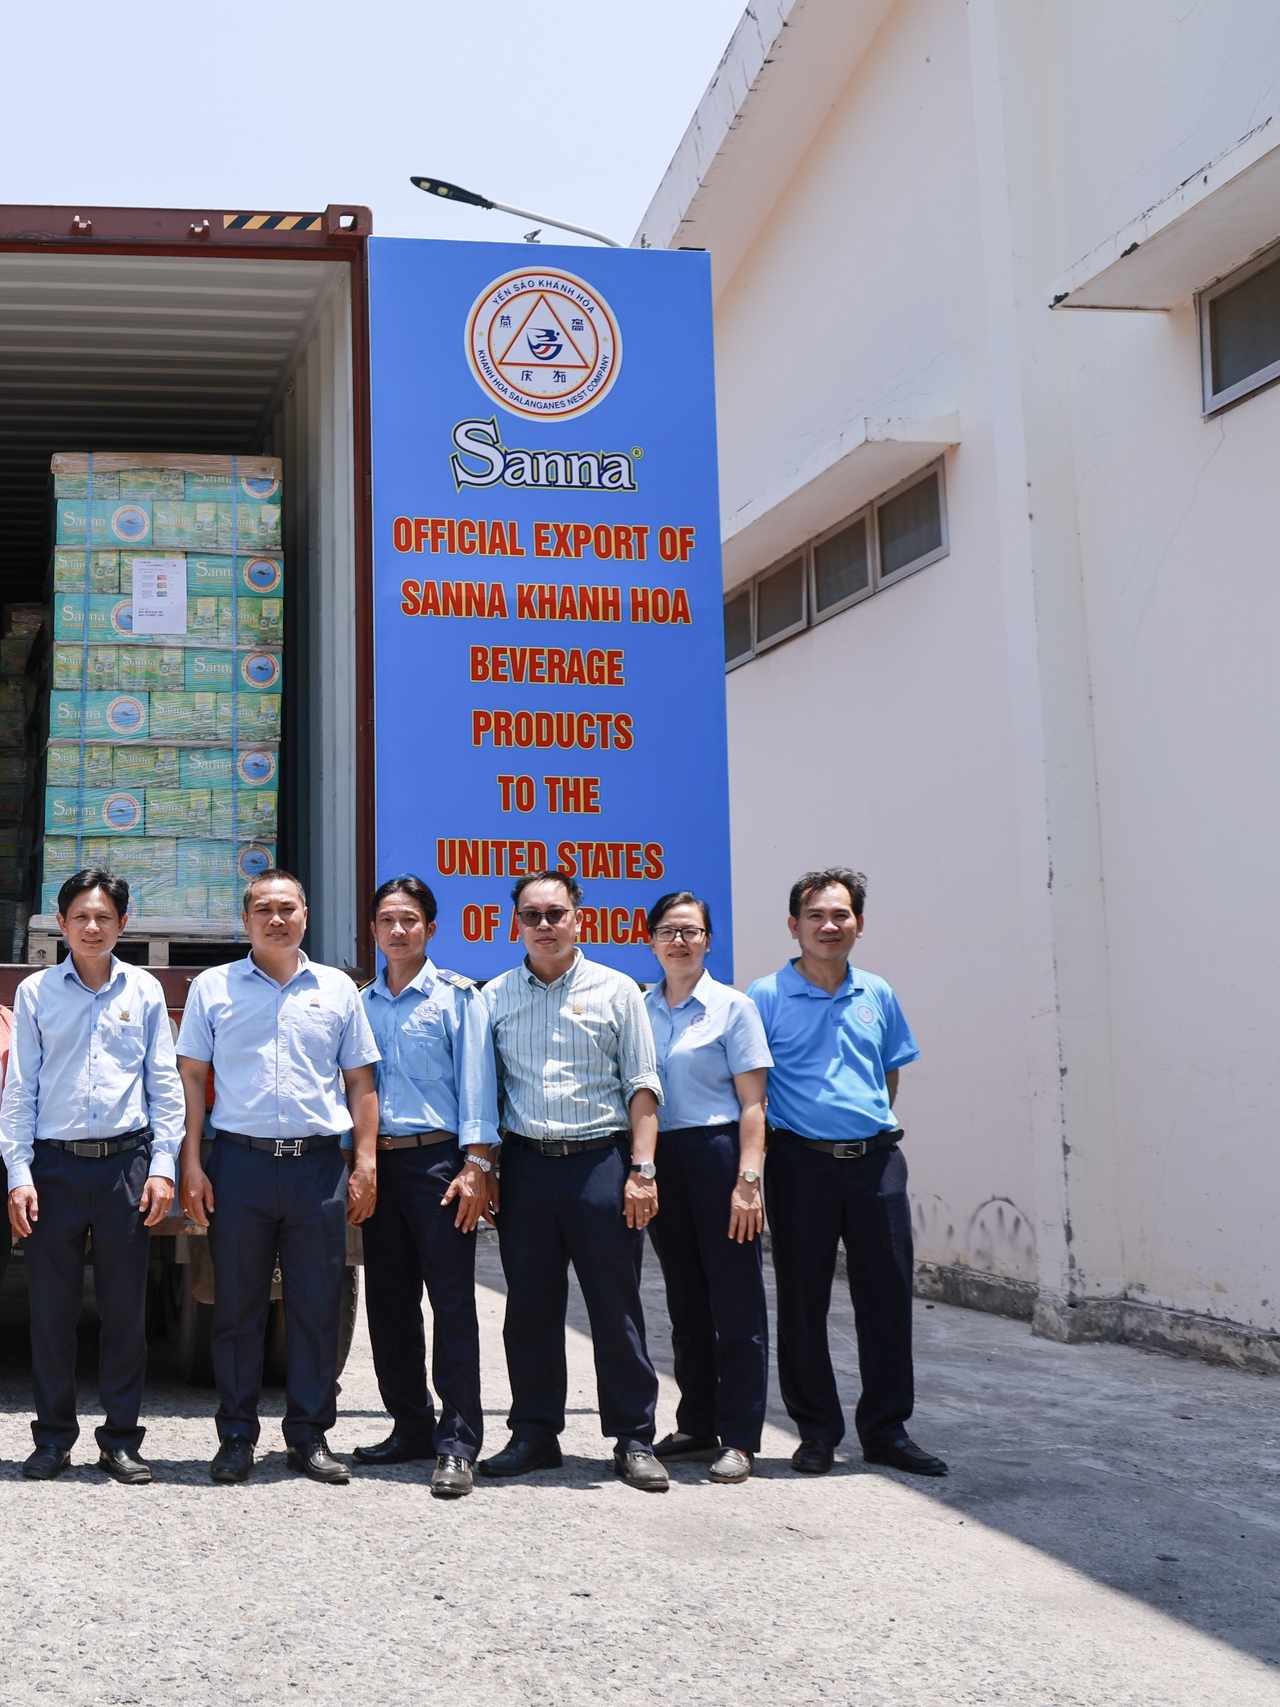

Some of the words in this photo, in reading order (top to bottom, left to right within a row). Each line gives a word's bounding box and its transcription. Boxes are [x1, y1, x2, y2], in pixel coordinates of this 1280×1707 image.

[538, 279, 575, 296] KHÁNH
[478, 349, 495, 379] KHANH
[492, 377, 508, 395] HOA
[508, 391, 566, 409] SALANGANES
[567, 390, 588, 405] NEST
[586, 354, 610, 392] COMPANY
[449, 415, 638, 494] Sanna
[392, 516, 526, 557] OFFICIAL
[533, 522, 650, 561] EXPORT
[658, 525, 695, 562] OF
[58, 556, 87, 569] Sann
[400, 579, 509, 619] SANNA
[516, 583, 622, 623] KHANH
[629, 587, 692, 625] HOA
[122, 653, 156, 666] Sanna
[469, 645, 625, 686] BEVERAGE
[472, 709, 634, 751] PRODUCTS
[189, 753, 232, 770] Sanna
[496, 774, 536, 813] TO
[543, 775, 601, 814] THE
[436, 838, 548, 878] UNITED
[556, 840, 665, 881] STATES
[462, 903, 501, 943] OF
